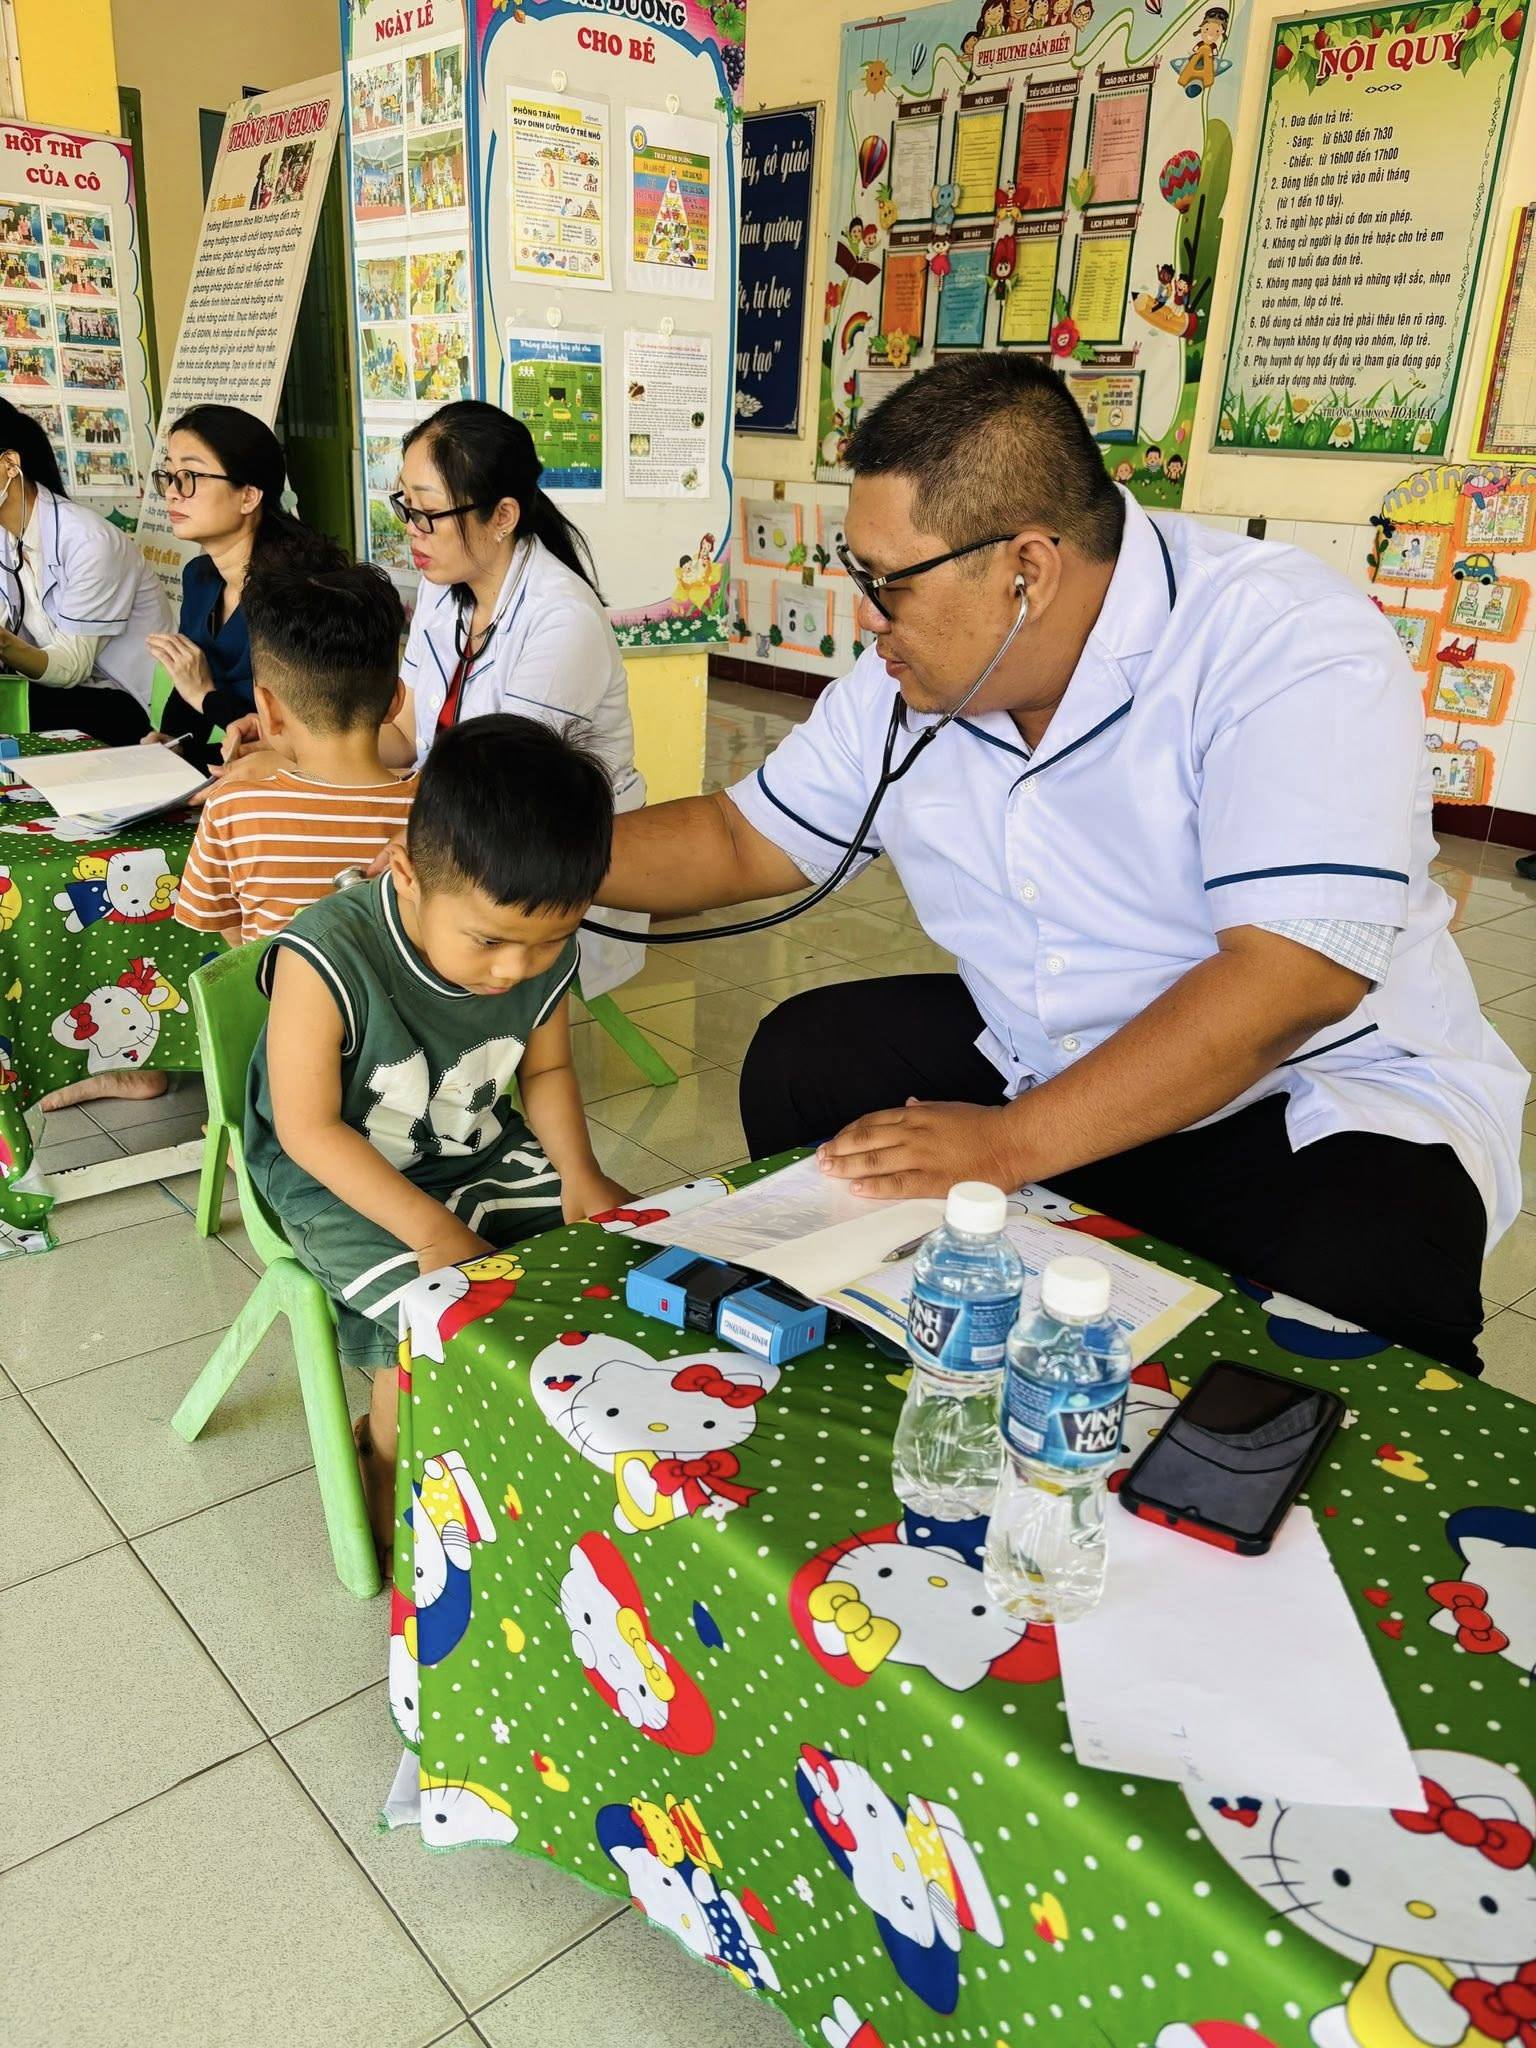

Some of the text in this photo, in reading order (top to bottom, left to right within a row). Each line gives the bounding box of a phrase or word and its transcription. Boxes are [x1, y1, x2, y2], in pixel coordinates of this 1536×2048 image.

[376, 9, 413, 41] NGÀY
[578, 27, 656, 64] CHO BÉ
[978, 30, 1071, 69] PHỤ HUYNH CẦN BIẾT
[1316, 31, 1465, 82] NỘI QUY
[228, 99, 330, 152] THÔNG TIN CHUNG
[513, 105, 561, 120] PHÒNG TRÁNH
[1281, 107, 1354, 129] 1. Đưa đón trả trẻ:
[513, 118, 527, 126] SUY
[576, 128, 588, 138] TRẺ
[588, 131, 601, 140] NHỎ
[1292, 125, 1394, 151] Sáng: từ 6h30 đến 7h30
[5, 131, 82, 159] HỘI THI
[1319, 151, 1329, 166] từ
[1330, 148, 1355, 167] 16h00
[1356, 147, 1372, 163] đến
[1374, 145, 1400, 164] 17h00
[763, 143, 778, 177] cô
[781, 140, 809, 184] giáo
[26, 163, 101, 191] CỦA CÔ
[1271, 176, 1279, 191] 2.
[1281, 175, 1302, 192] Đóng
[1321, 172, 1336, 190] cho
[1337, 169, 1349, 185] trẻ
[1351, 167, 1367, 185] vào
[1386, 166, 1411, 184] tháng
[740, 210, 803, 252] ấm gương
[1265, 217, 1273, 231] 3.
[1276, 214, 1289, 230] Trẻ
[1309, 214, 1324, 230] học
[1325, 210, 1344, 230] phải
[1345, 211, 1356, 225] có
[1358, 211, 1373, 225] đơn
[1375, 210, 1388, 224] xin
[1389, 208, 1413, 226] phép.
[1262, 237, 1270, 250] 4.
[1272, 236, 1297, 251] Không
[1309, 231, 1333, 250] người
[1334, 231, 1342, 249] lạ
[1344, 231, 1360, 246] đón
[1362, 230, 1374, 245] trẻ
[1376, 231, 1397, 247] hoặc
[1398, 229, 1414, 244] cho
[1416, 227, 1428, 243] trẻ
[1430, 231, 1445, 242] em
[1256, 277, 1264, 290] 5.
[1266, 276, 1290, 291] Không
[1292, 277, 1314, 290] mang
[1332, 272, 1352, 289] bánh
[1354, 272, 1364, 287] và
[1408, 268, 1426, 287] sắc,
[1429, 270, 1452, 286] nhọn
[753, 280, 768, 319] tự
[768, 275, 792, 319] học
[1250, 315, 1259, 329] 6.
[1273, 314, 1292, 331] dùng
[1293, 313, 1303, 328] cá
[1305, 314, 1325, 328] nhân
[1326, 312, 1341, 329] của
[1343, 312, 1355, 328] trẻ
[1356, 311, 1376, 330] phải
[1377, 312, 1396, 327] thêu
[1397, 312, 1412, 329] tên
[1413, 312, 1424, 329] rõ
[1425, 311, 1447, 329] ràng.
[1244, 354, 1251, 368] 8.
[1253, 354, 1268, 369] Phụ
[1270, 353, 1293, 369] huynh
[1306, 353, 1321, 369] họp
[1339, 351, 1350, 367] đủ
[1352, 351, 1362, 370] và
[1363, 353, 1386, 370] tham
[1386, 353, 1401, 370] gia
[1402, 351, 1424, 370] đóng
[1425, 353, 1442, 370] góp
[1390, 405, 1413, 420] HOA
[1415, 406, 1436, 421] MAI
